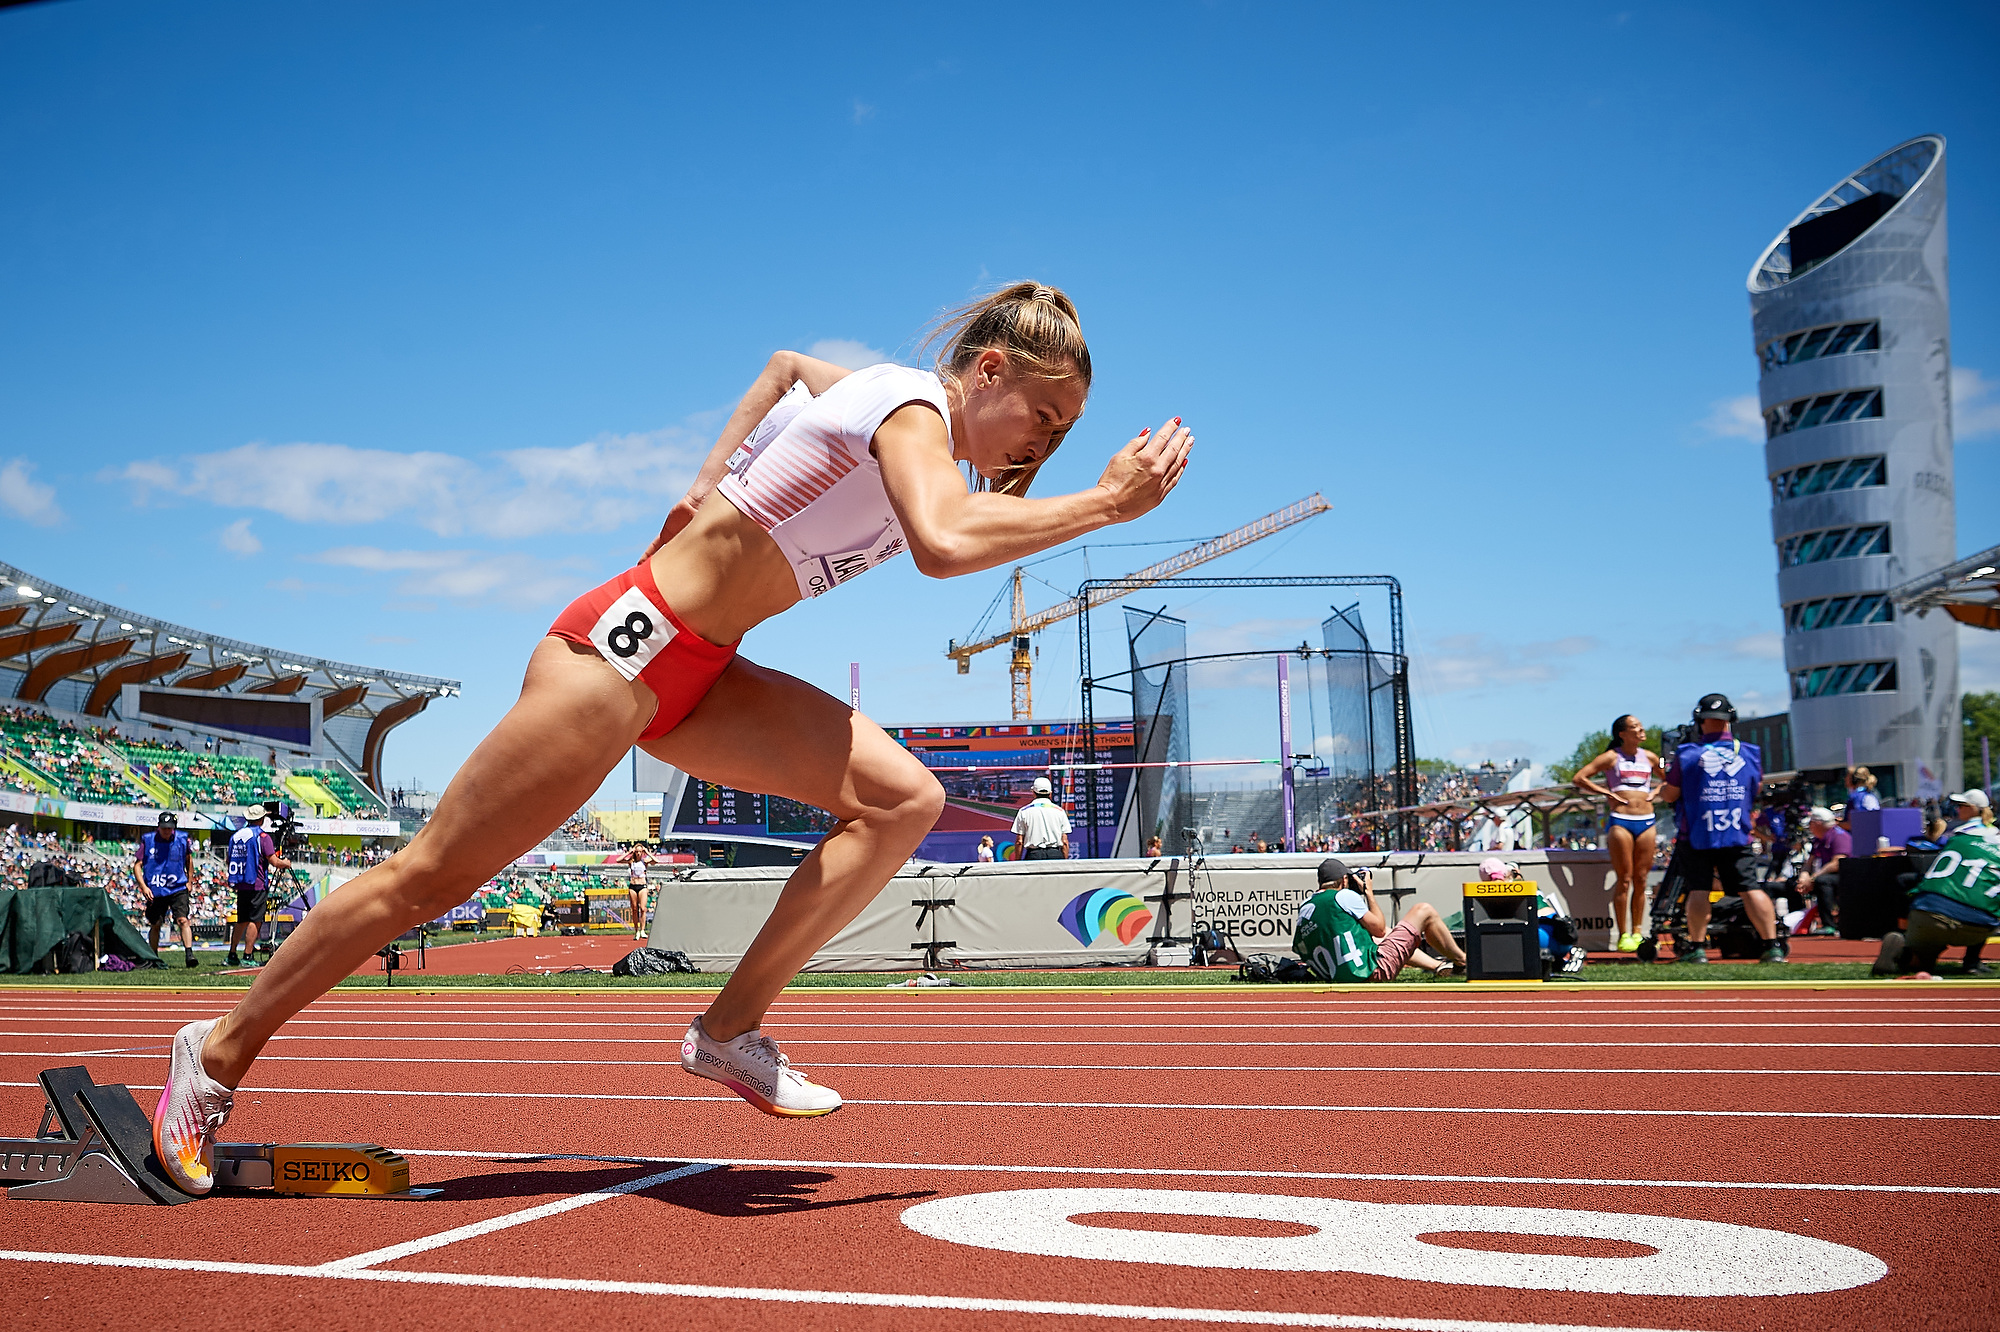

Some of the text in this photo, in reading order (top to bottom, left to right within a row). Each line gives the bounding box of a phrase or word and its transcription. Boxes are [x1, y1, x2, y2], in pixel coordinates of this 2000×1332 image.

[607, 611, 653, 658] 8
[697, 791, 703, 799] 5
[150, 874, 178, 887] 452
[1476, 884, 1524, 894] SEIKO
[1195, 892, 1243, 903] WORLD
[695, 1049, 773, 1097] new balance
[283, 1162, 370, 1182] SEIKO
[902, 1187, 1890, 1297] 8
